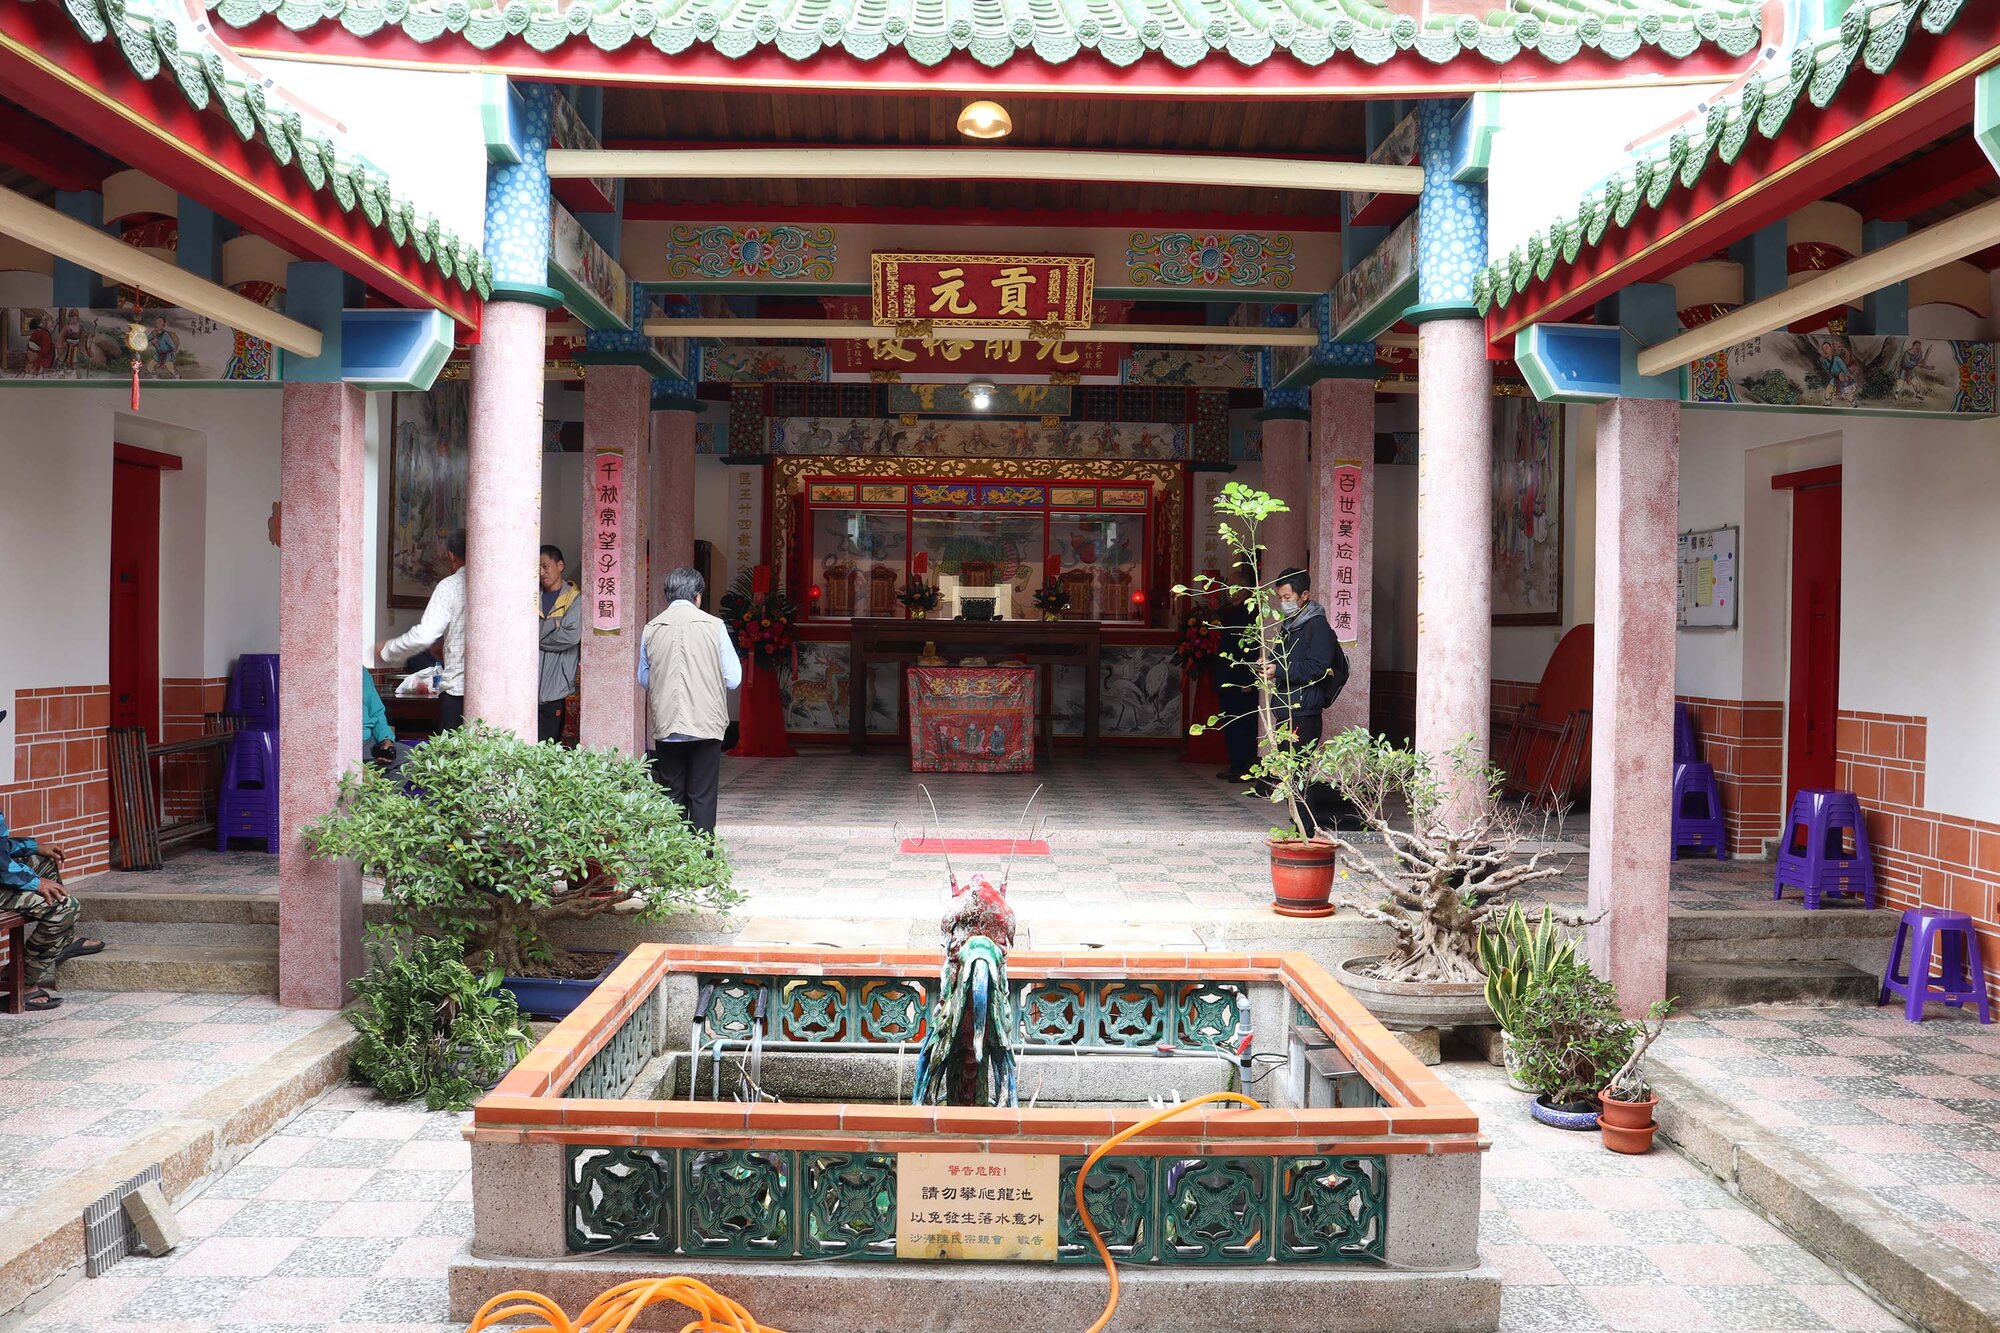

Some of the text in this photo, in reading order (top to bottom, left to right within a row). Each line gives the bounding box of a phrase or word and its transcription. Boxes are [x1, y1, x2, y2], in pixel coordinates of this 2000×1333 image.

[929, 267, 1036, 316] 貢元
[1334, 473, 1357, 631] 百世莫忘祖宗德
[948, 1165, 1007, 1176] 警告危險!
[922, 1186, 1033, 1201] 請勿攀爬龍池
[910, 1211, 1044, 1225] 以免發生落水意外
